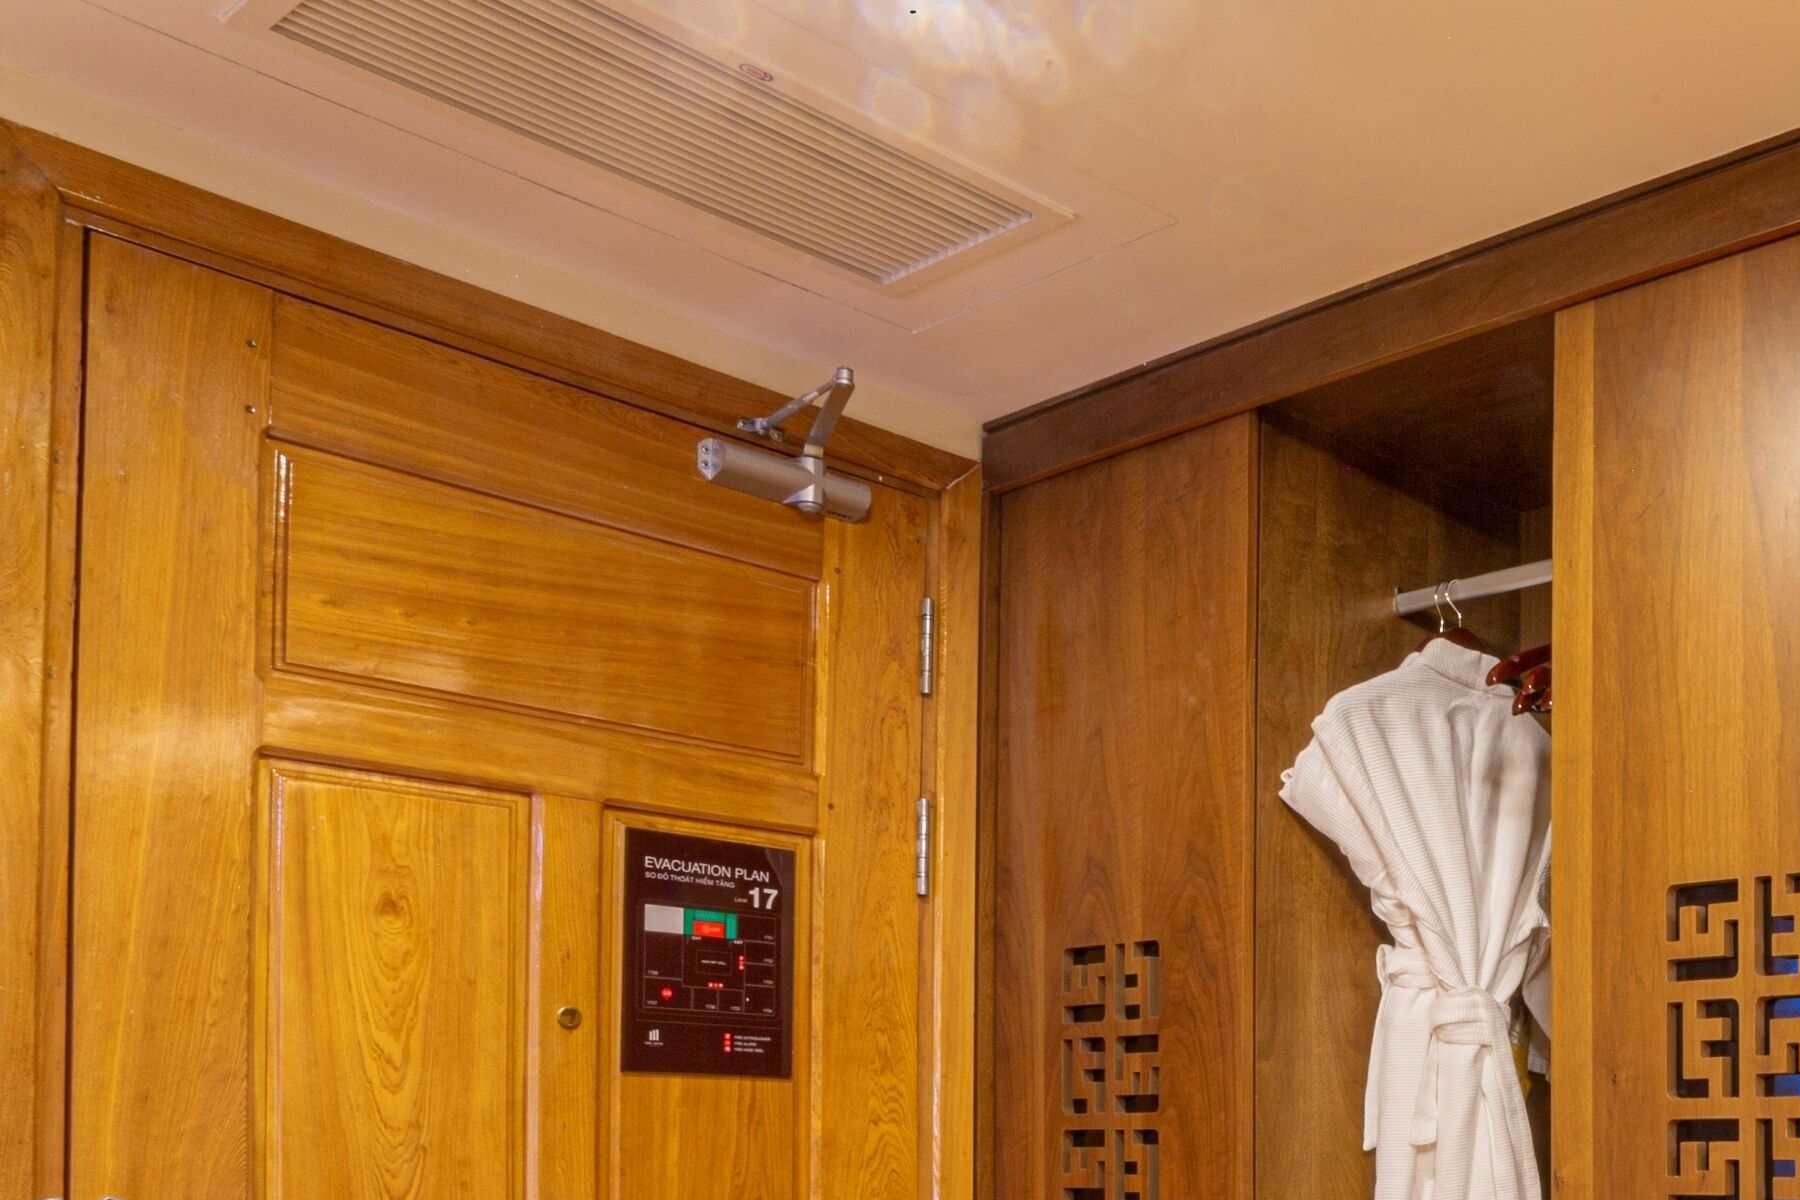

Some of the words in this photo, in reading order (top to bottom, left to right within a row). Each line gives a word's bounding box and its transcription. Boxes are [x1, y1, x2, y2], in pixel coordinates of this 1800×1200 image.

[644, 855, 731, 878] EVACUATION
[735, 867, 769, 883] PLAN
[748, 887, 778, 910] 17
